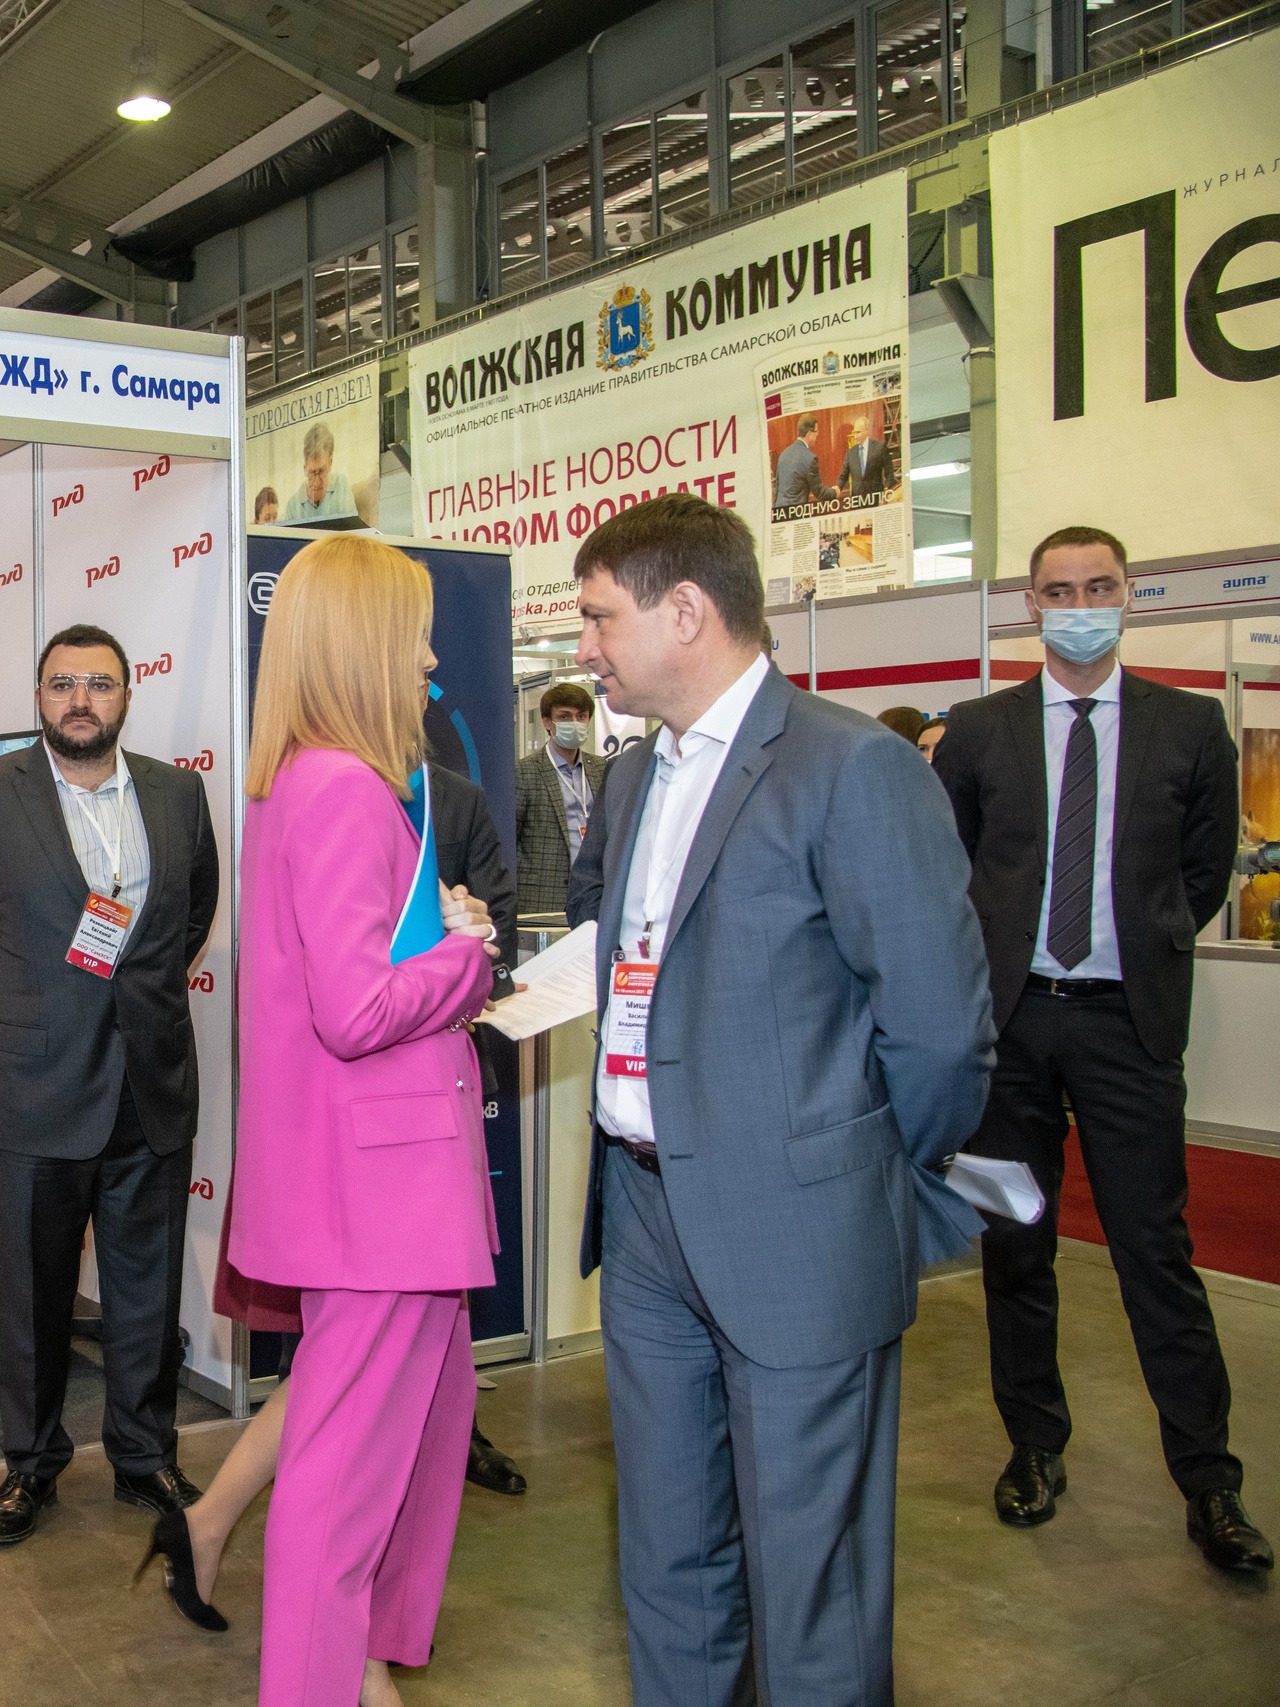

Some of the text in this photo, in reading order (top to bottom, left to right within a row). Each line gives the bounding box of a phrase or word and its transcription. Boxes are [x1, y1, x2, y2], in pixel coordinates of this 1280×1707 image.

[426, 222, 872, 416] ВОЛЖСКАЯ КОММУНА
[1053, 188, 1280, 421] Пе
[80, 370, 100, 394] г.
[111, 364, 220, 410] Самара
[426, 302, 872, 444] ОФИЦИАЛЬНОЕ ПЕЧАТНОЕ ИЗДАНИЕ ПРАВИТЕЛЬСТВА САМАРСКОЙ ОБЛАСТИ
[761, 343, 901, 388] ВОЛЖСКАЯ КОММУНА
[252, 391, 322, 436] ГОРОДСКАЯ
[326, 373, 373, 409] ГАЗЕТА
[428, 414, 738, 523] ГЛАВНЫЕ НОВОСТИ
[771, 489, 895, 521] НА РОДНУЮ ЗЕМЛЮ
[1134, 587, 1165, 598] uma
[1222, 575, 1267, 589] auma
[83, 956, 99, 968] VIP
[626, 1060, 646, 1072] VIP
